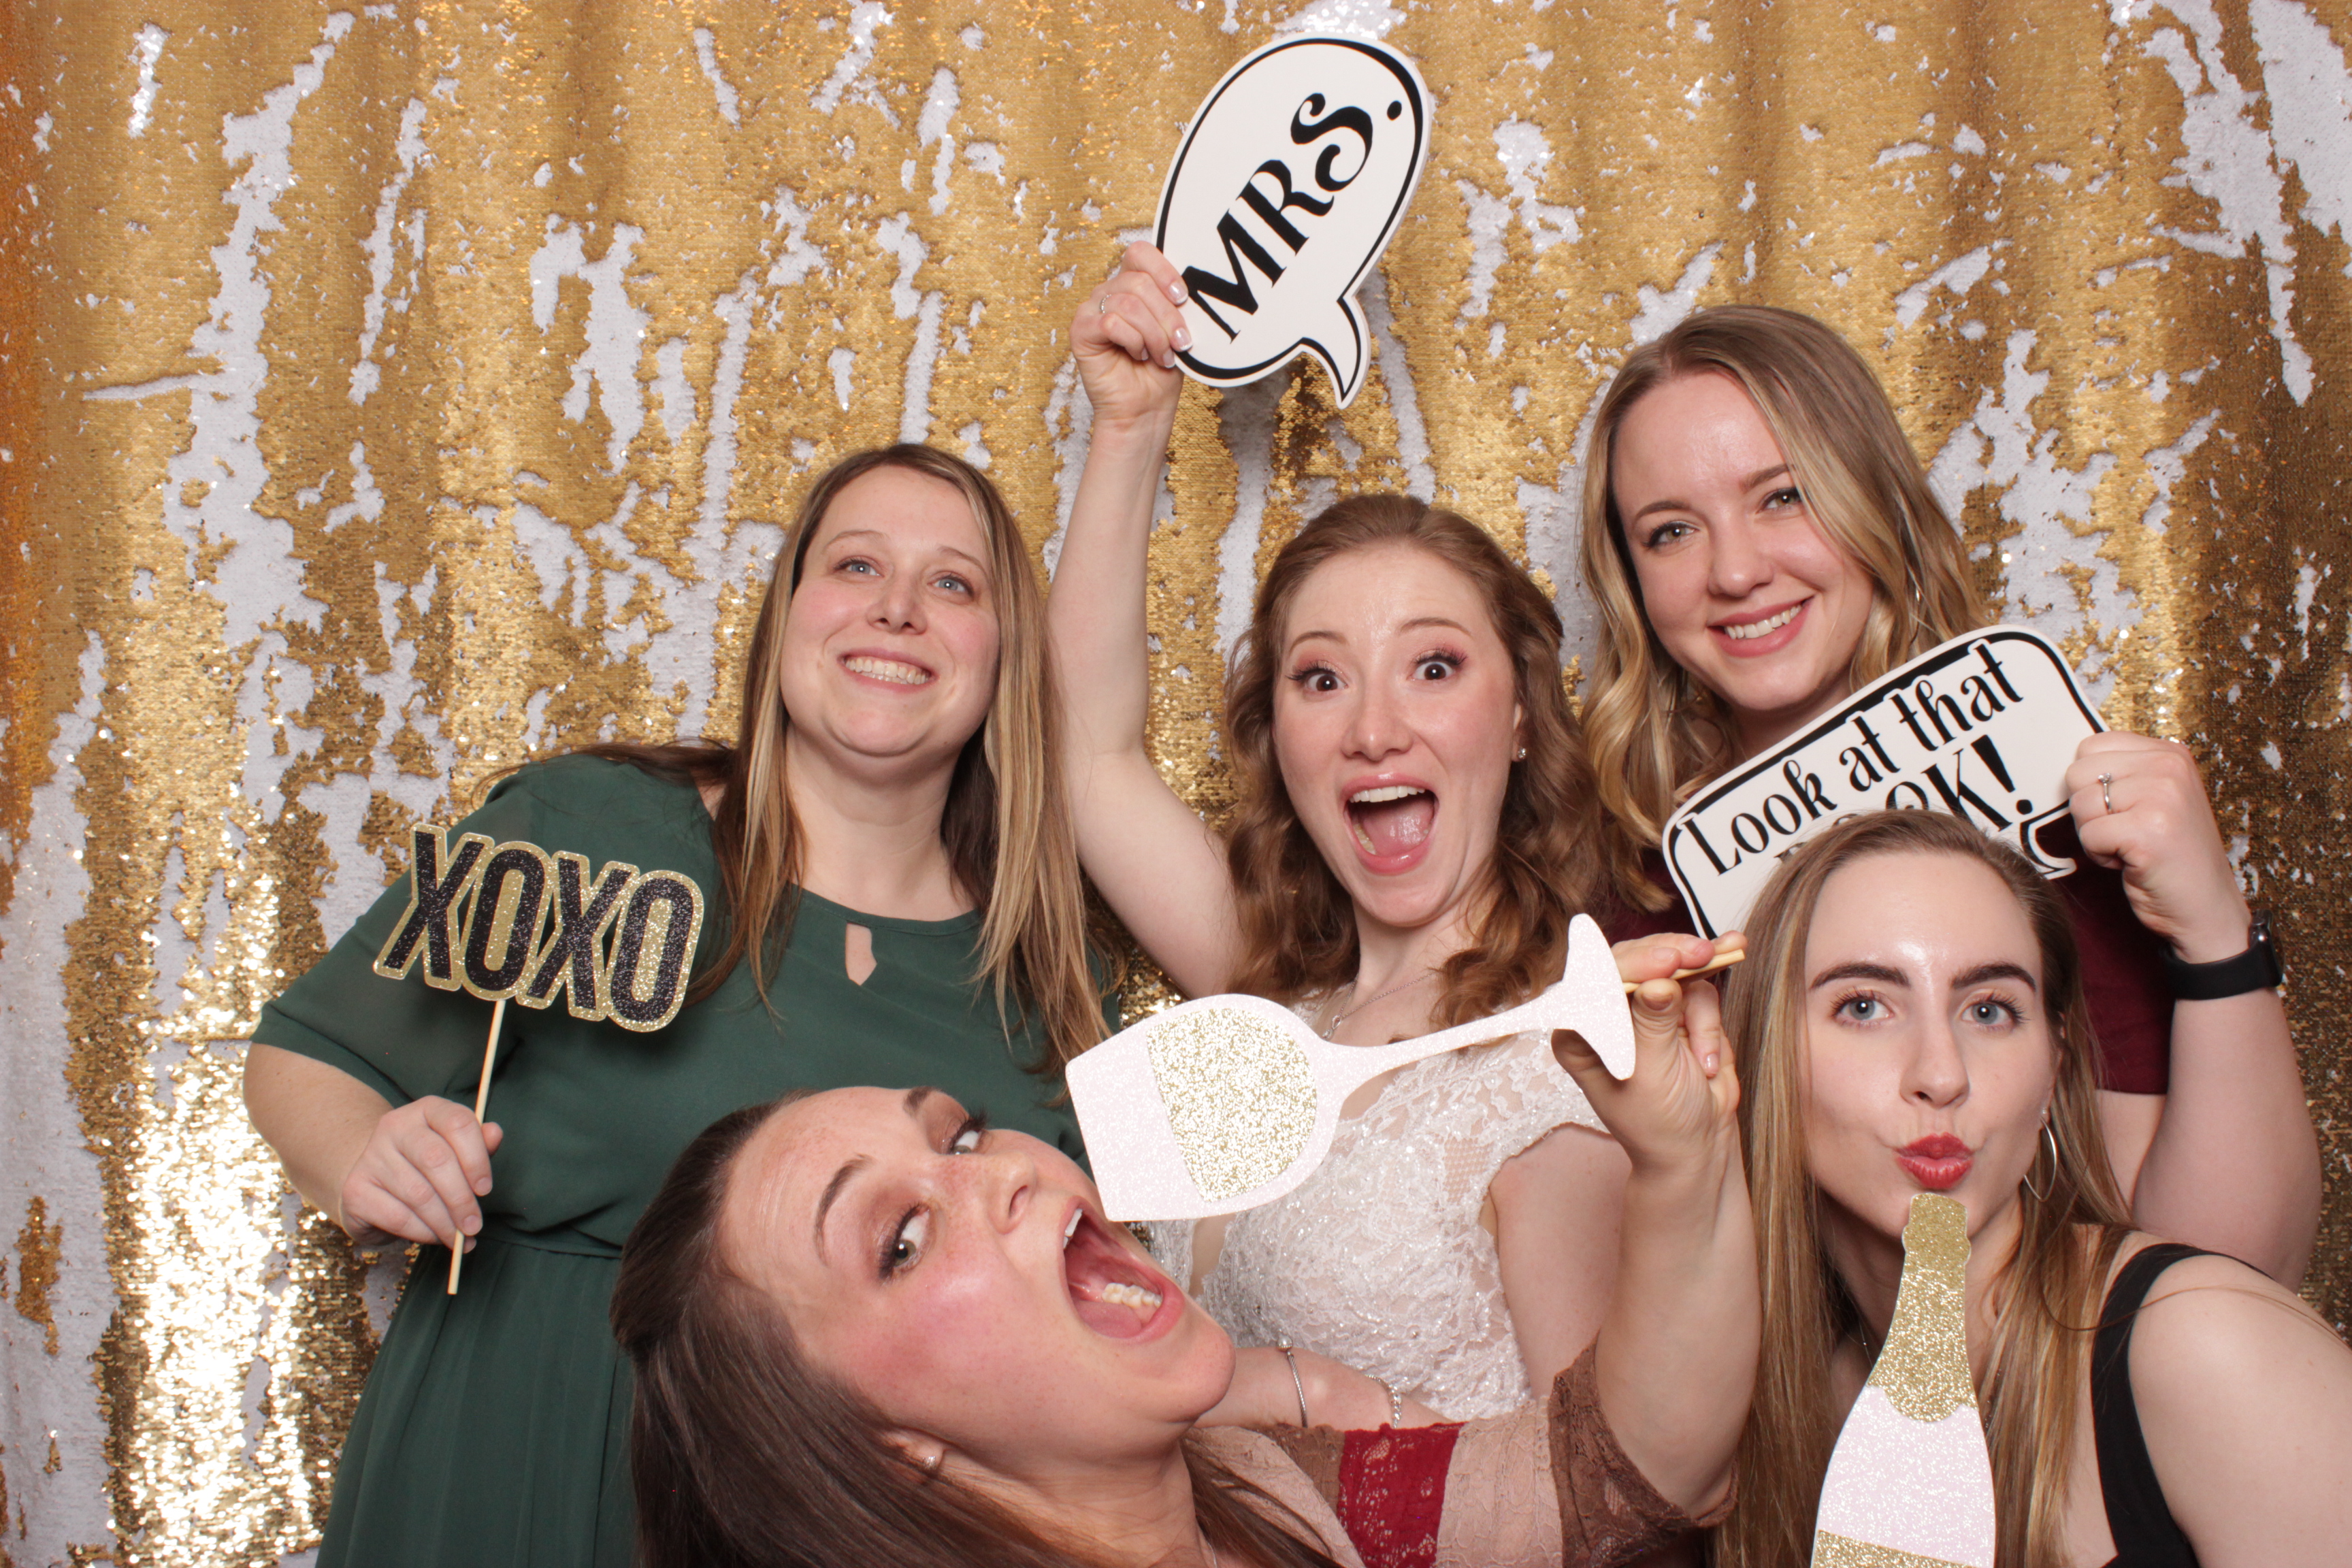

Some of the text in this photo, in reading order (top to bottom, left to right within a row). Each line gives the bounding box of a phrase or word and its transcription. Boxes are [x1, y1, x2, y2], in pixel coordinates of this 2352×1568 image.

[1181, 93, 1402, 344] MRS.
[1682, 759, 1838, 875] Look
[1839, 715, 1901, 792] at
[1888, 643, 2023, 751] that
[383, 830, 695, 1022] XOXO
